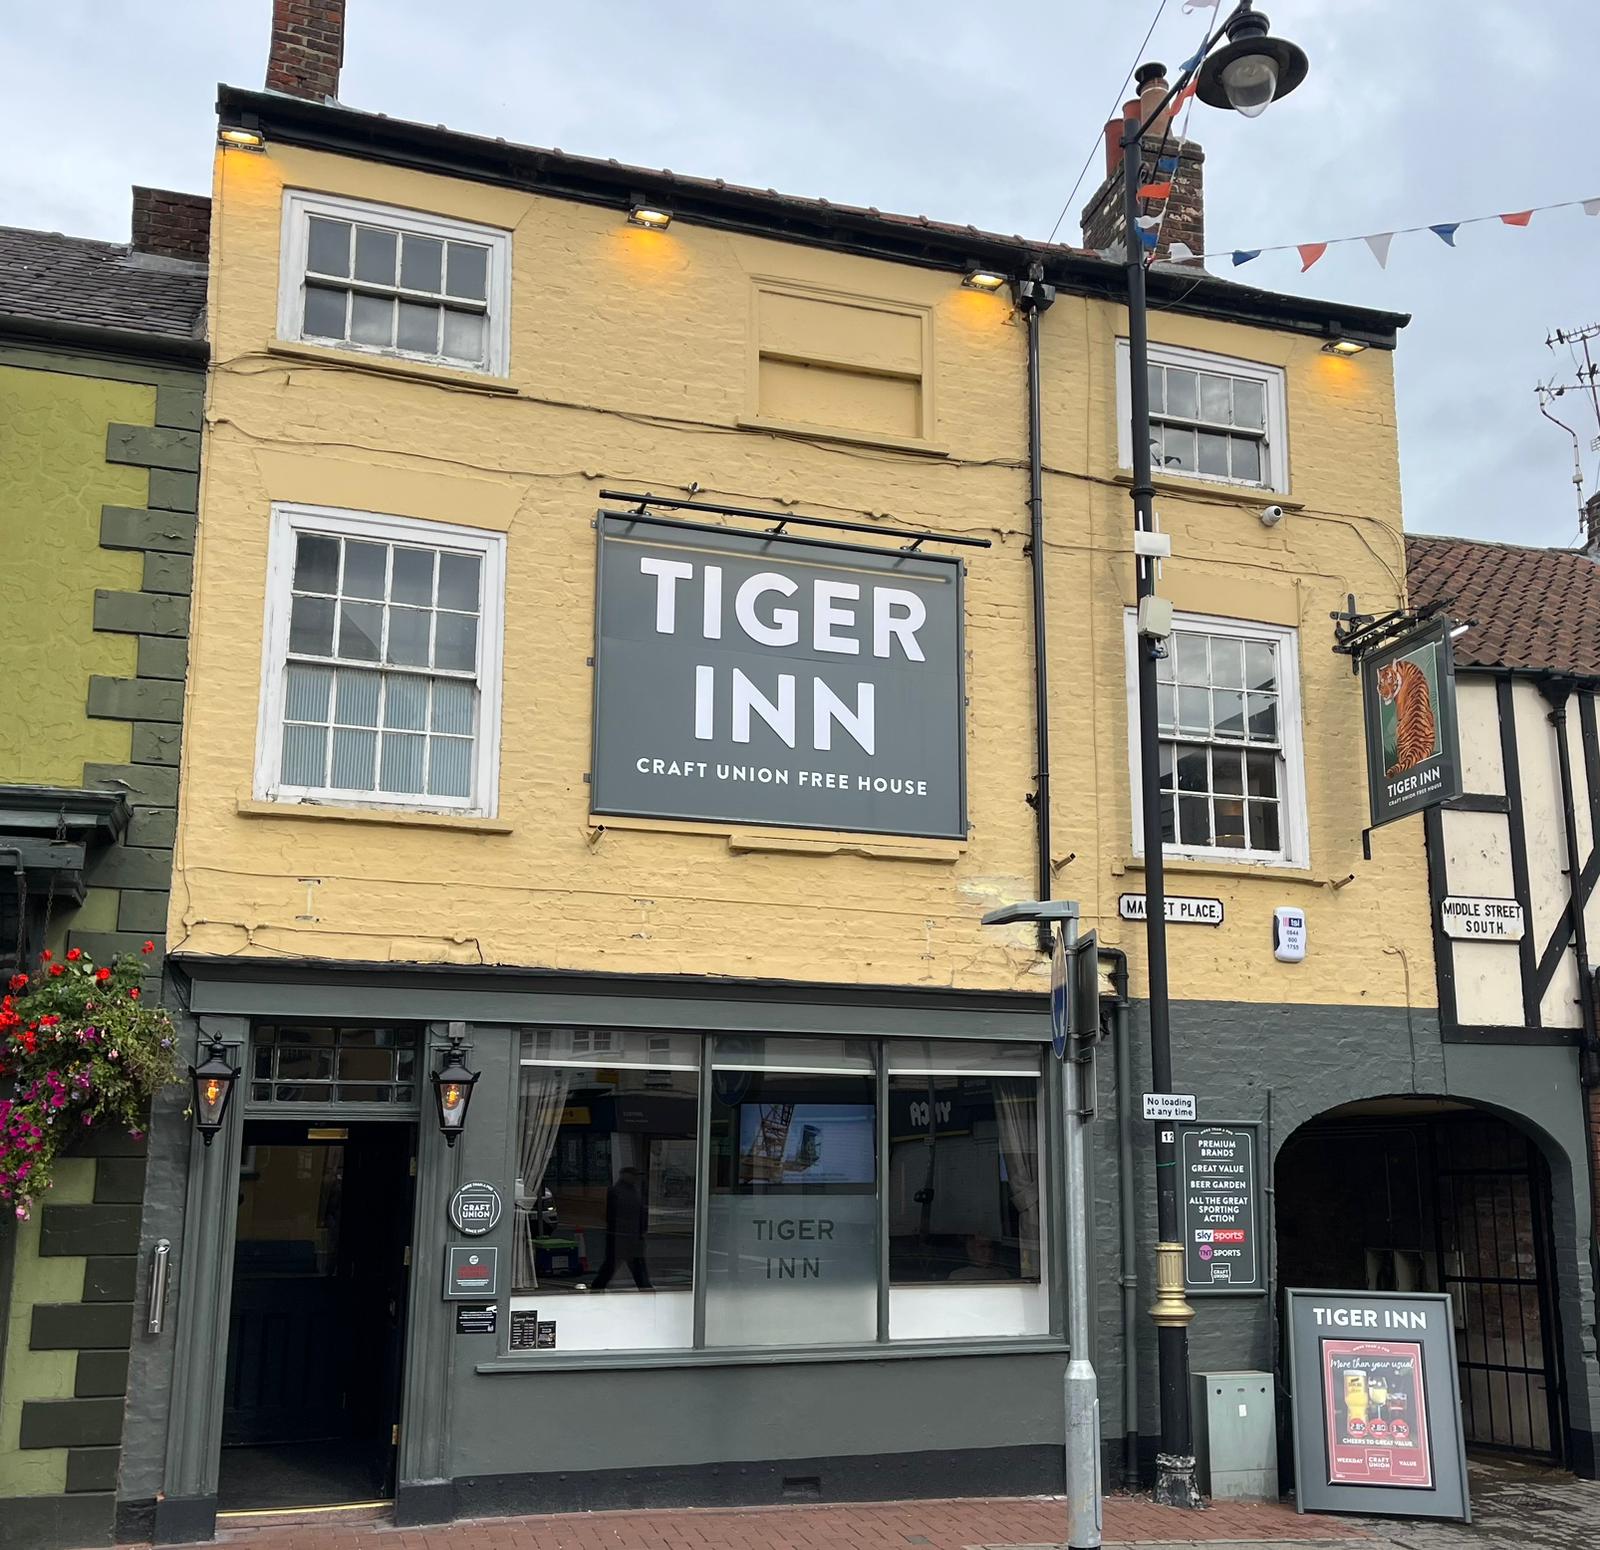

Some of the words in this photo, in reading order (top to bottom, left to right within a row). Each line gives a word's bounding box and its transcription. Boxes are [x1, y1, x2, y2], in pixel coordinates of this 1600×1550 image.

[640, 557, 926, 662] TIGER
[695, 665, 875, 755] INN
[636, 757, 707, 778] CRAFT
[716, 764, 788, 784] UNION
[799, 771, 849, 789] FREE
[858, 776, 927, 796] HOUSE
[1388, 776, 1417, 797] TIGER
[1420, 766, 1440, 785] INN
[1388, 797, 1401, 806] CRAFT
[1127, 900, 1174, 916] MAT
[1181, 903, 1219, 918] PLACE.
[1444, 903, 1480, 916] MIDDLE
[1485, 904, 1520, 918] STREET
[1466, 920, 1506, 934] SOUTH.
[1162, 1098, 1191, 1107] loading
[1175, 1108, 1192, 1116] time
[1199, 1140, 1235, 1148] PREMIUM
[1223, 1197, 1248, 1205] GREAT
[753, 1220, 834, 1240] TIGER
[1197, 1231, 1212, 1240] sky
[1215, 1232, 1243, 1240] sports
[767, 1257, 820, 1279] INN
[1313, 1308, 1378, 1327] TIGER
[1385, 1311, 1427, 1329] INN
[1330, 1359, 1351, 1368] More
[1353, 1358, 1370, 1368] than
[1371, 1361, 1390, 1371] your
[1392, 1359, 1414, 1368] usual
